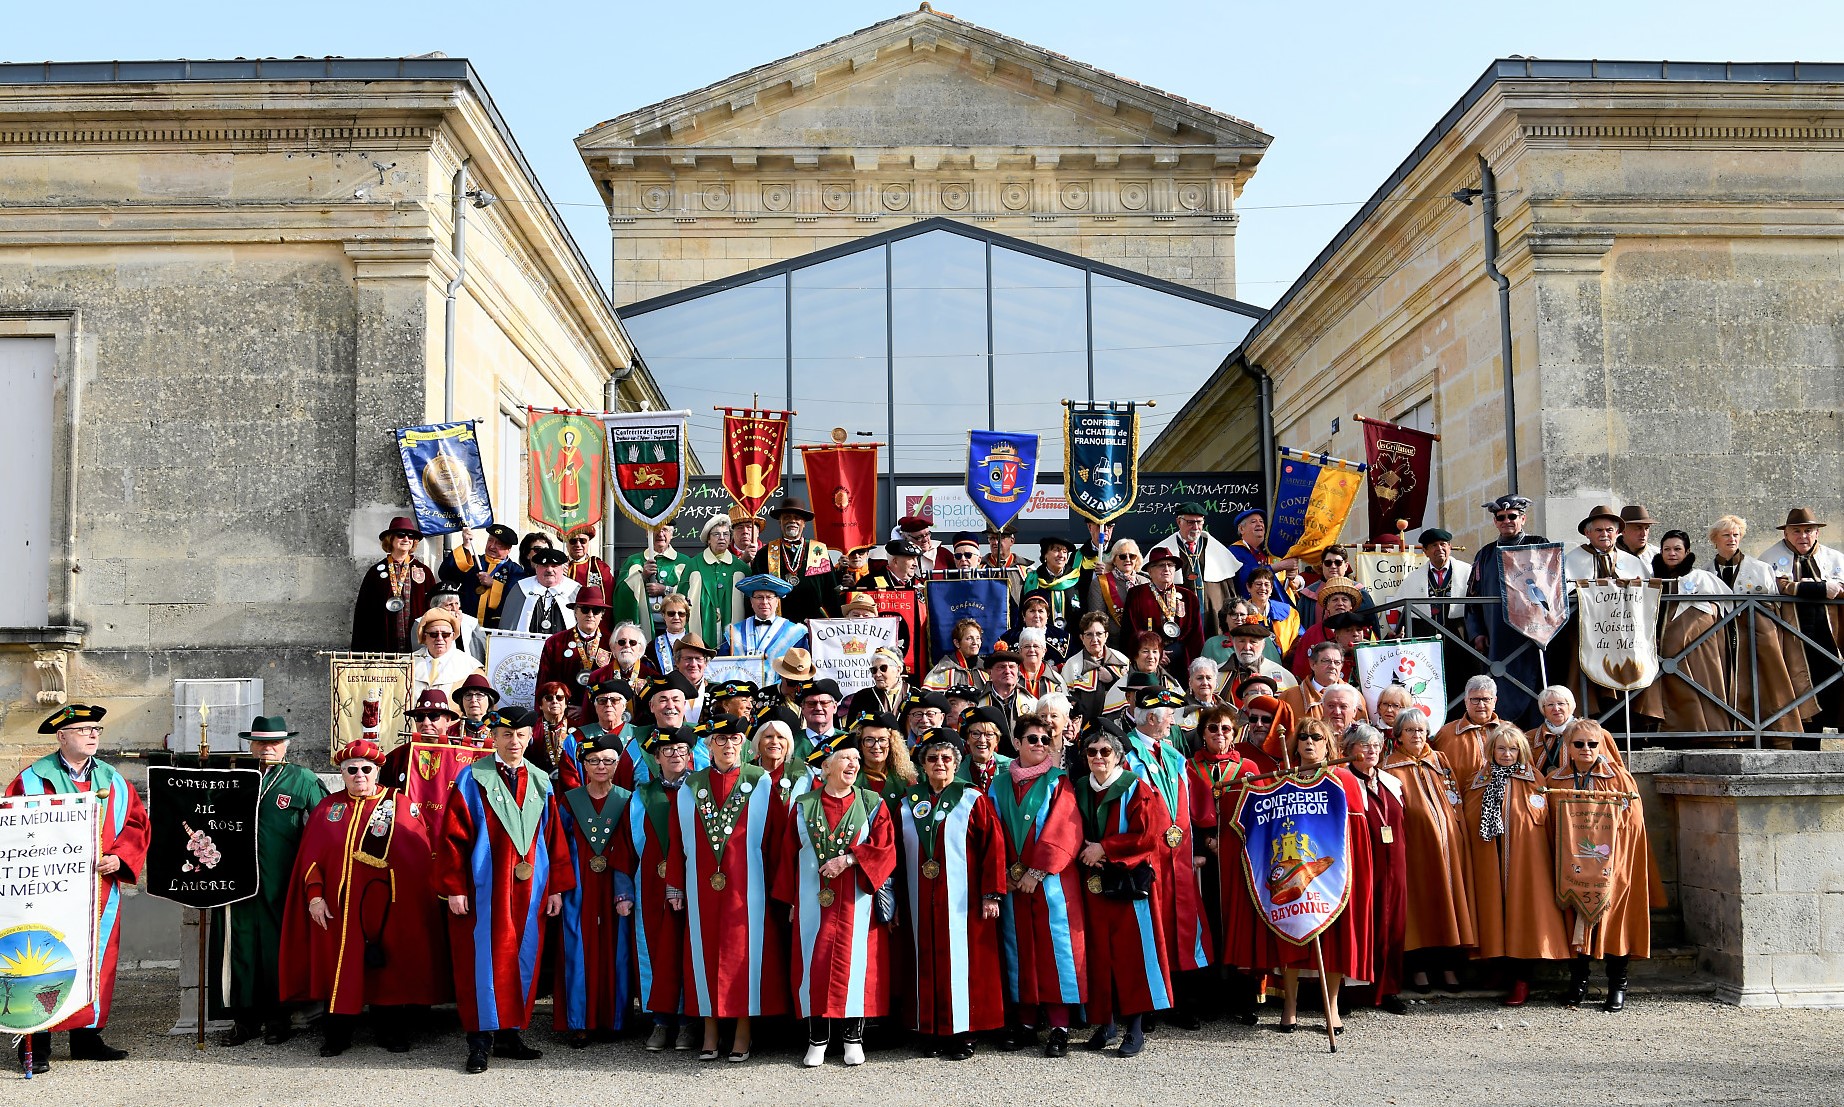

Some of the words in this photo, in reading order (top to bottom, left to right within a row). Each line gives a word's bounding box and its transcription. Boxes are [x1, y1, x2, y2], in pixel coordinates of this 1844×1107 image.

[1074, 428, 1084, 436] du
[1118, 429, 1128, 437] de
[1079, 490, 1122, 511] BIZANOS
[1203, 498, 1253, 514] MÉDOC
[944, 516, 984, 527] médoc
[1610, 607, 1621, 618] de
[1622, 609, 1632, 619] la
[1596, 637, 1610, 649] du
[815, 657, 871, 669] GASTRONOM
[347, 675, 360, 683] LES
[360, 675, 398, 683] TALMELIERS
[837, 670, 851, 680] DU
[426, 801, 444, 811] Pays
[1254, 791, 1329, 813] CONFRERIE
[194, 803, 216, 814] AIL
[1271, 802, 1329, 820] JAMBON
[20, 809, 87, 826] MÉDULIEN
[208, 819, 244, 832] ROSE
[62, 843, 83, 855] de
[18, 865, 40, 879] DE
[43, 861, 87, 877] VIVRE
[10, 879, 69, 897] MÉDOC
[1306, 891, 1321, 901] DE
[1270, 902, 1331, 923] BAYONNE
